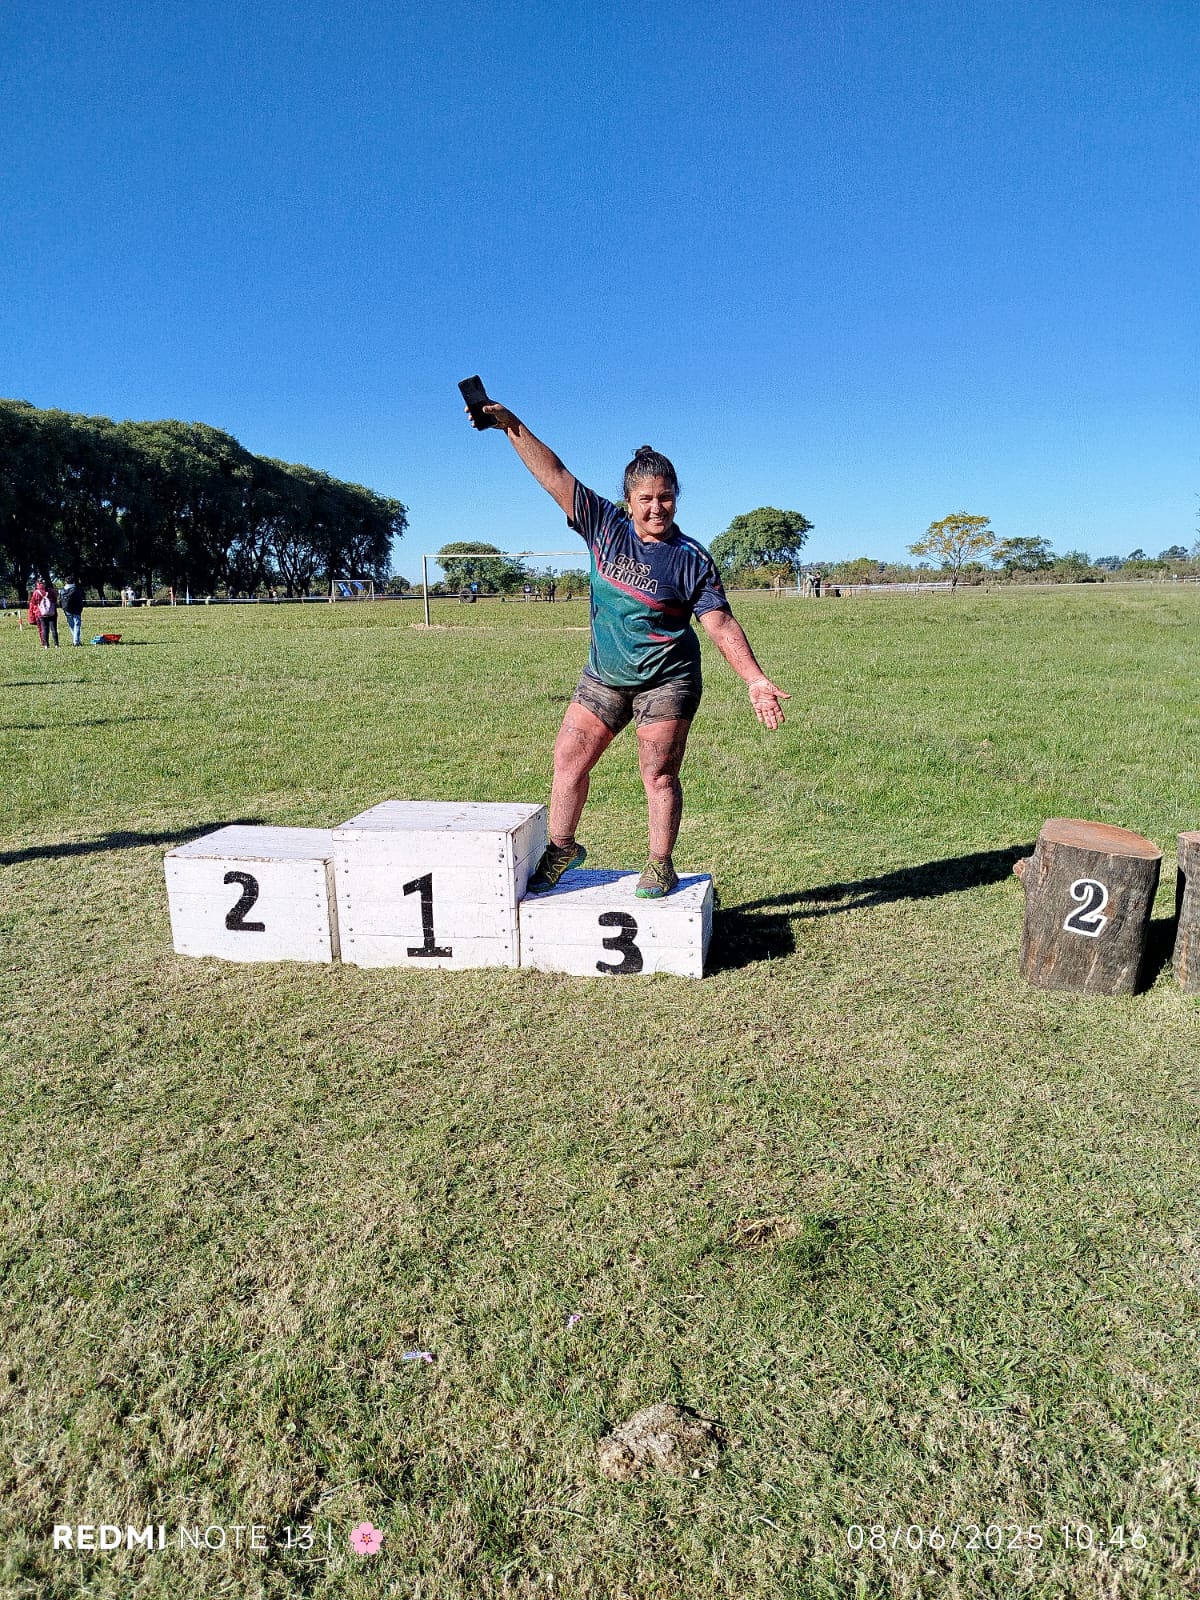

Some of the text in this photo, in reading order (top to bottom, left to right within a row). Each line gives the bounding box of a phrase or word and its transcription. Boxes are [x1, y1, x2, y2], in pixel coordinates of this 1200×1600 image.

[614, 553, 651, 576] CROSS
[223, 871, 266, 932] 2
[402, 872, 453, 957] 1
[1063, 878, 1109, 937] 2
[595, 911, 644, 974] 3
